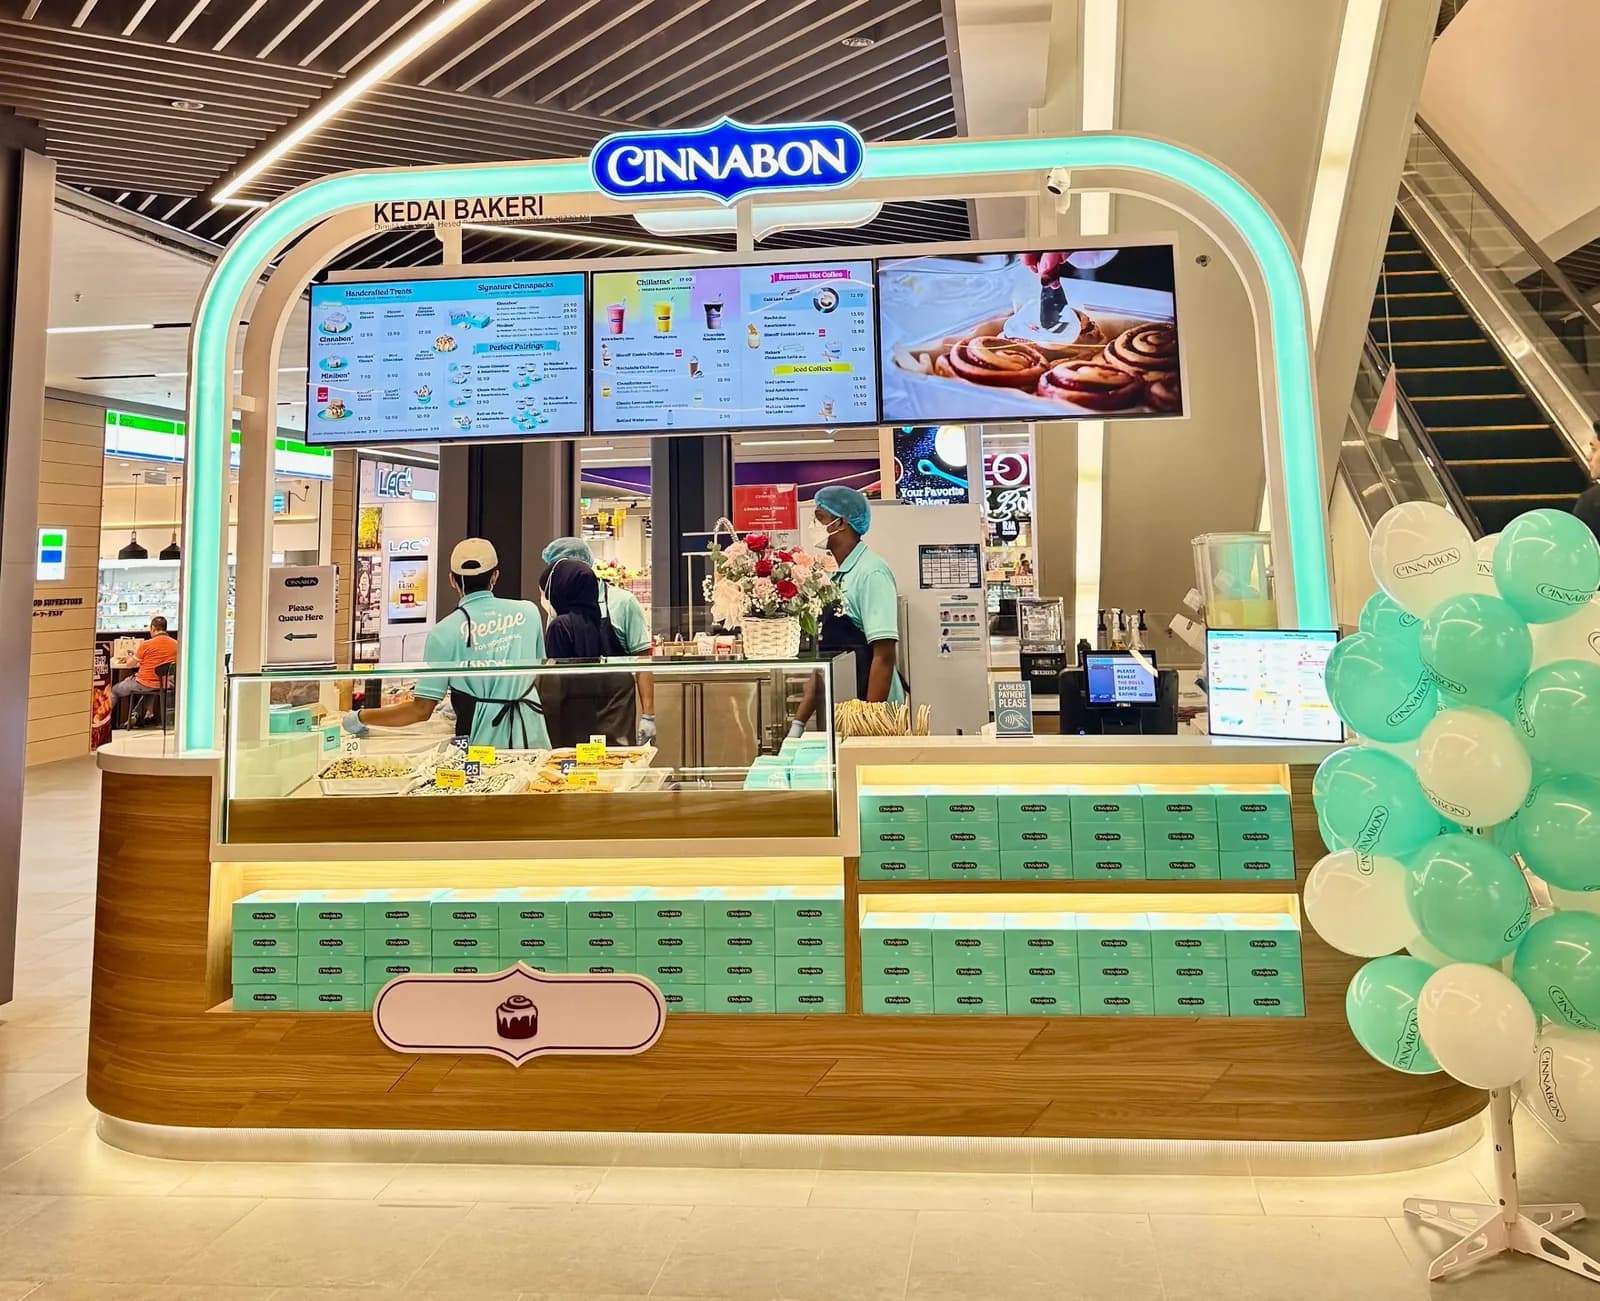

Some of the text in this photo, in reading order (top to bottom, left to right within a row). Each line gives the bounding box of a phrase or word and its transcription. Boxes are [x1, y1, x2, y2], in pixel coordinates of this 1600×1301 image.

[608, 138, 847, 187] CINNABON
[374, 200, 446, 223] KEDAI
[455, 195, 543, 220] BAKERI
[478, 283, 512, 292] Signature
[489, 343, 513, 351] Perfect
[378, 469, 410, 497] LAC
[900, 486, 965, 498] Your Favorite
[916, 497, 950, 506] Bakery
[389, 541, 420, 552] LAC
[1396, 550, 1459, 577] CINNABON
[288, 604, 314, 612] Please
[278, 614, 304, 622] Queue
[460, 611, 526, 646] Recipe
[998, 690, 1026, 699] PAYMENT
[998, 698, 1027, 708] PLEASE
[346, 741, 359, 752] 20
[466, 764, 479, 775] 25
[1541, 1050, 1564, 1118] CINNABON
